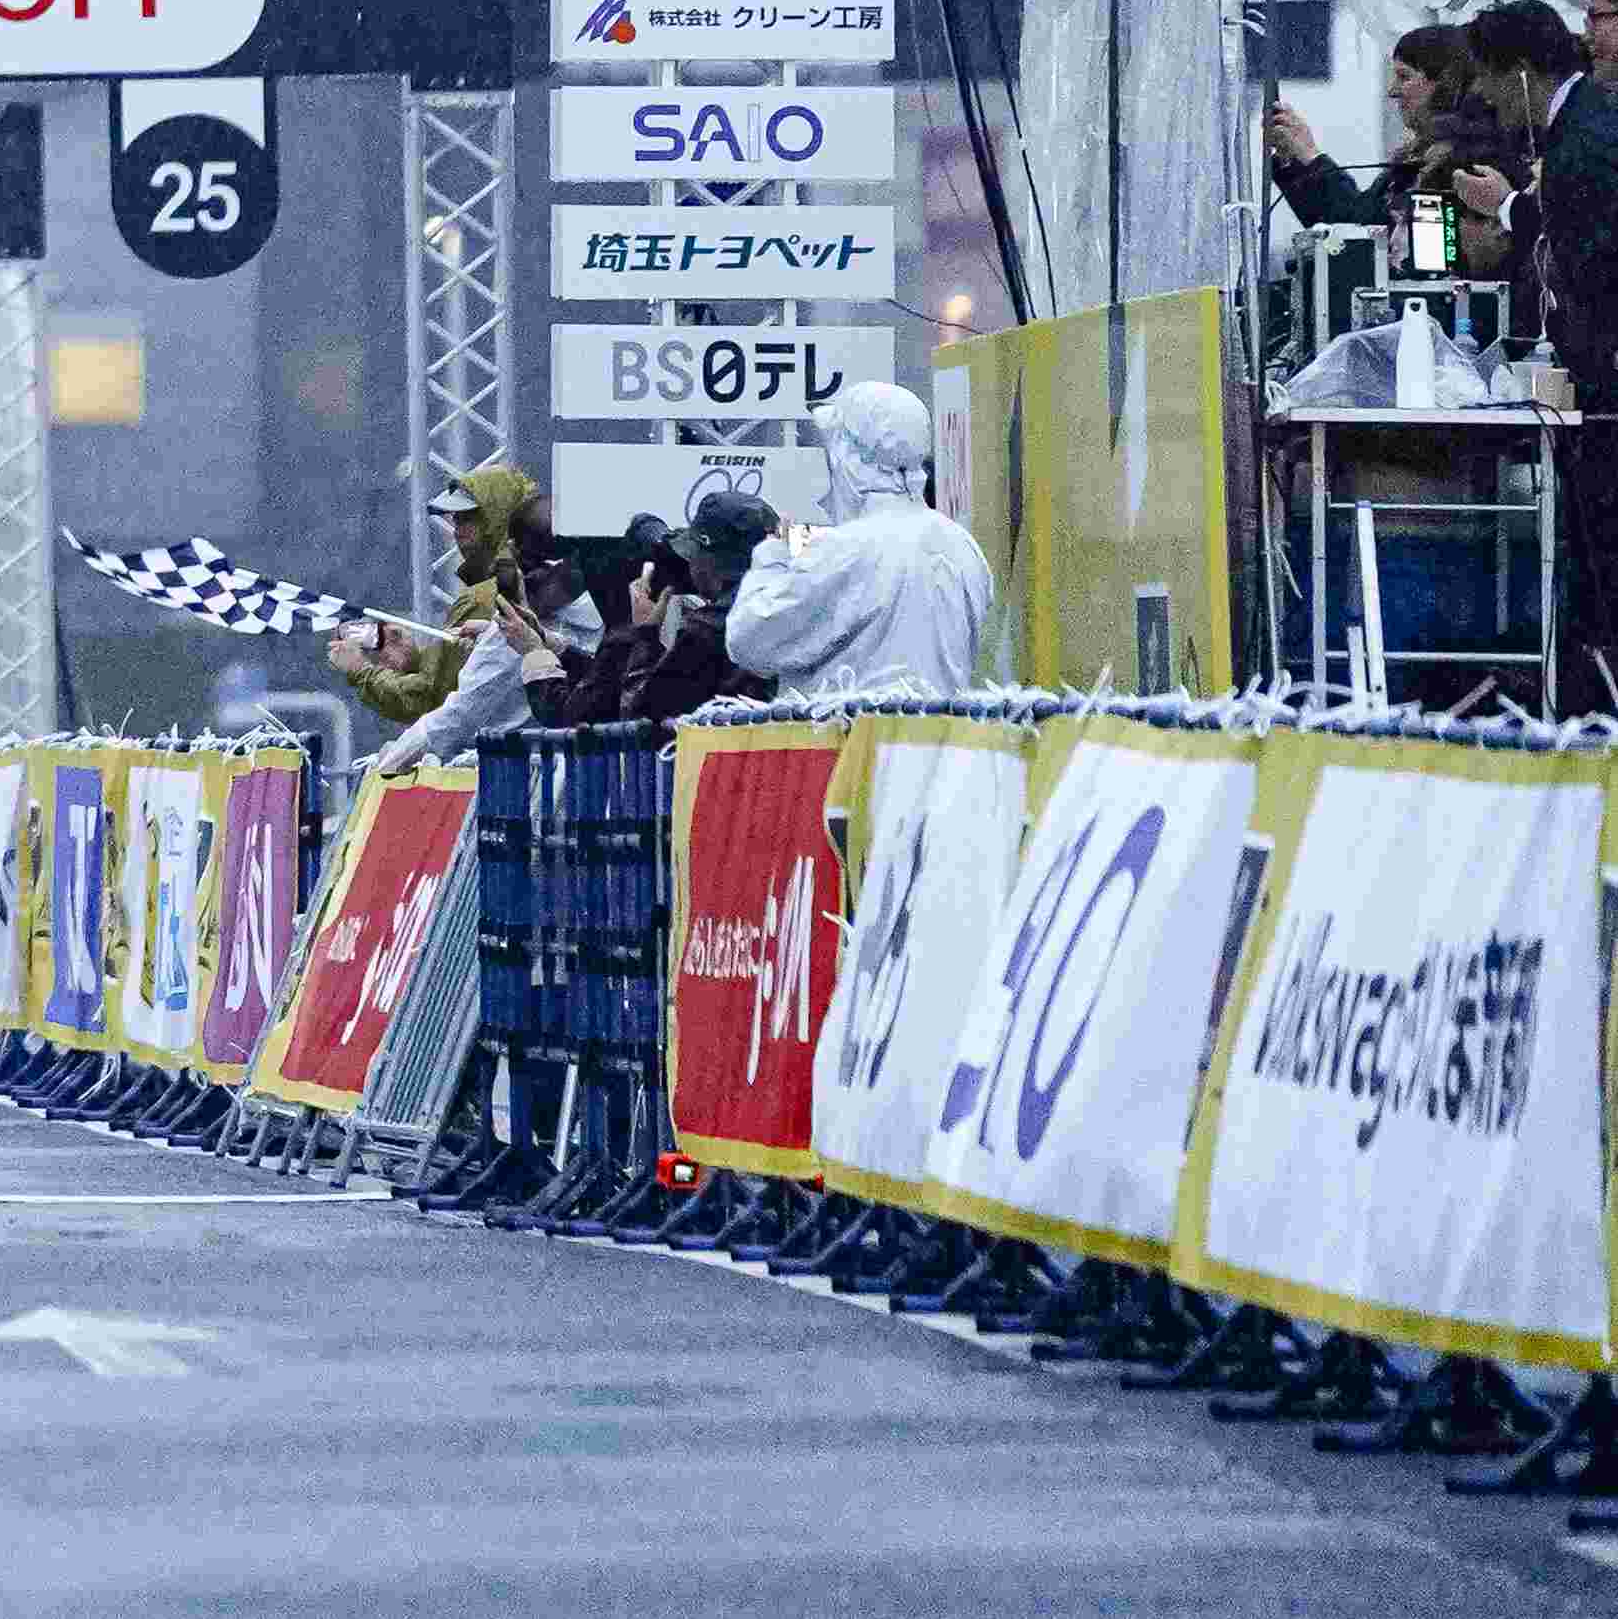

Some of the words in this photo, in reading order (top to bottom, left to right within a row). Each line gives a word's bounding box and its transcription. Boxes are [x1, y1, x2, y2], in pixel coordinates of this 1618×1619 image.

[648, 7, 721, 28] 株式会社
[733, 5, 884, 30] クリーン工房
[148, 160, 241, 234] 25
[582, 233, 875, 274] 埼玉トヨペット
